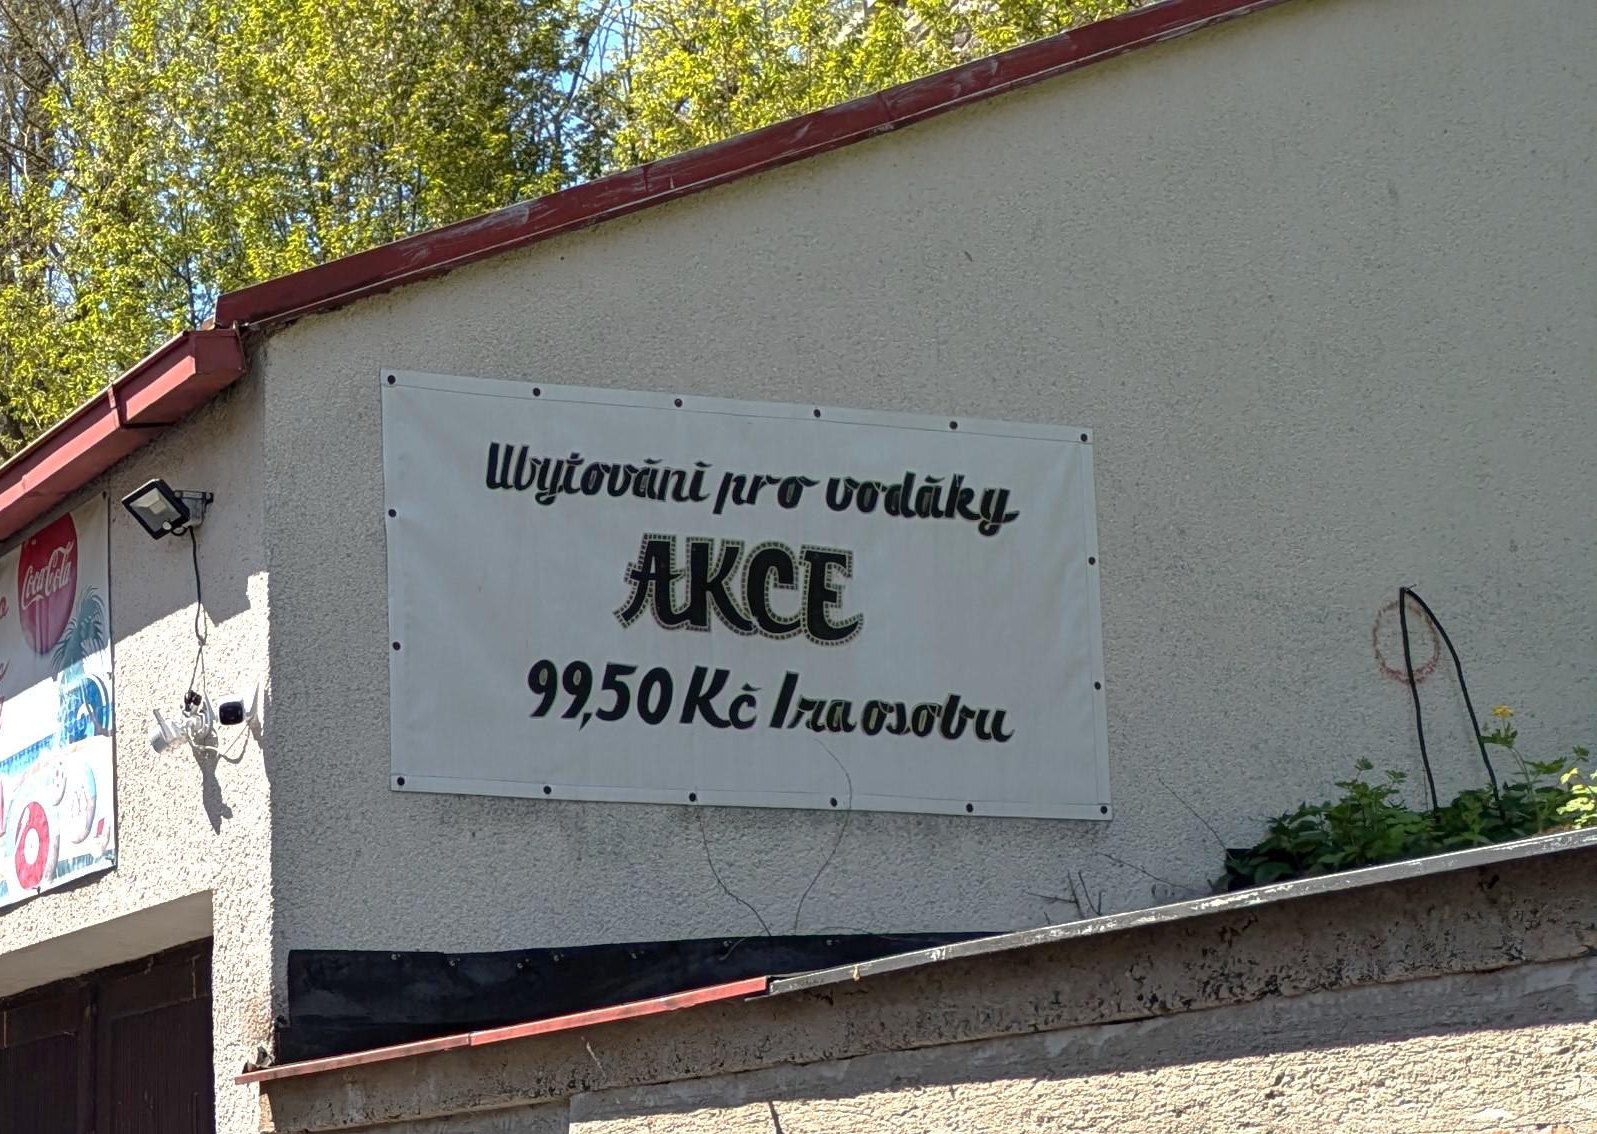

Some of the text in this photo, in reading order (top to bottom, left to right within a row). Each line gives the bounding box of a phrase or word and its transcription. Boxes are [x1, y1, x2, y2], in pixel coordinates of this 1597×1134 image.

[485, 441, 1021, 537] Ubytování pro vodáky
[21, 540, 75, 611] Coca-Cola
[612, 532, 865, 648] AKCE
[527, 658, 674, 732] 99,50
[679, 665, 762, 731] Kč
[861, 692, 1016, 743] osobu
